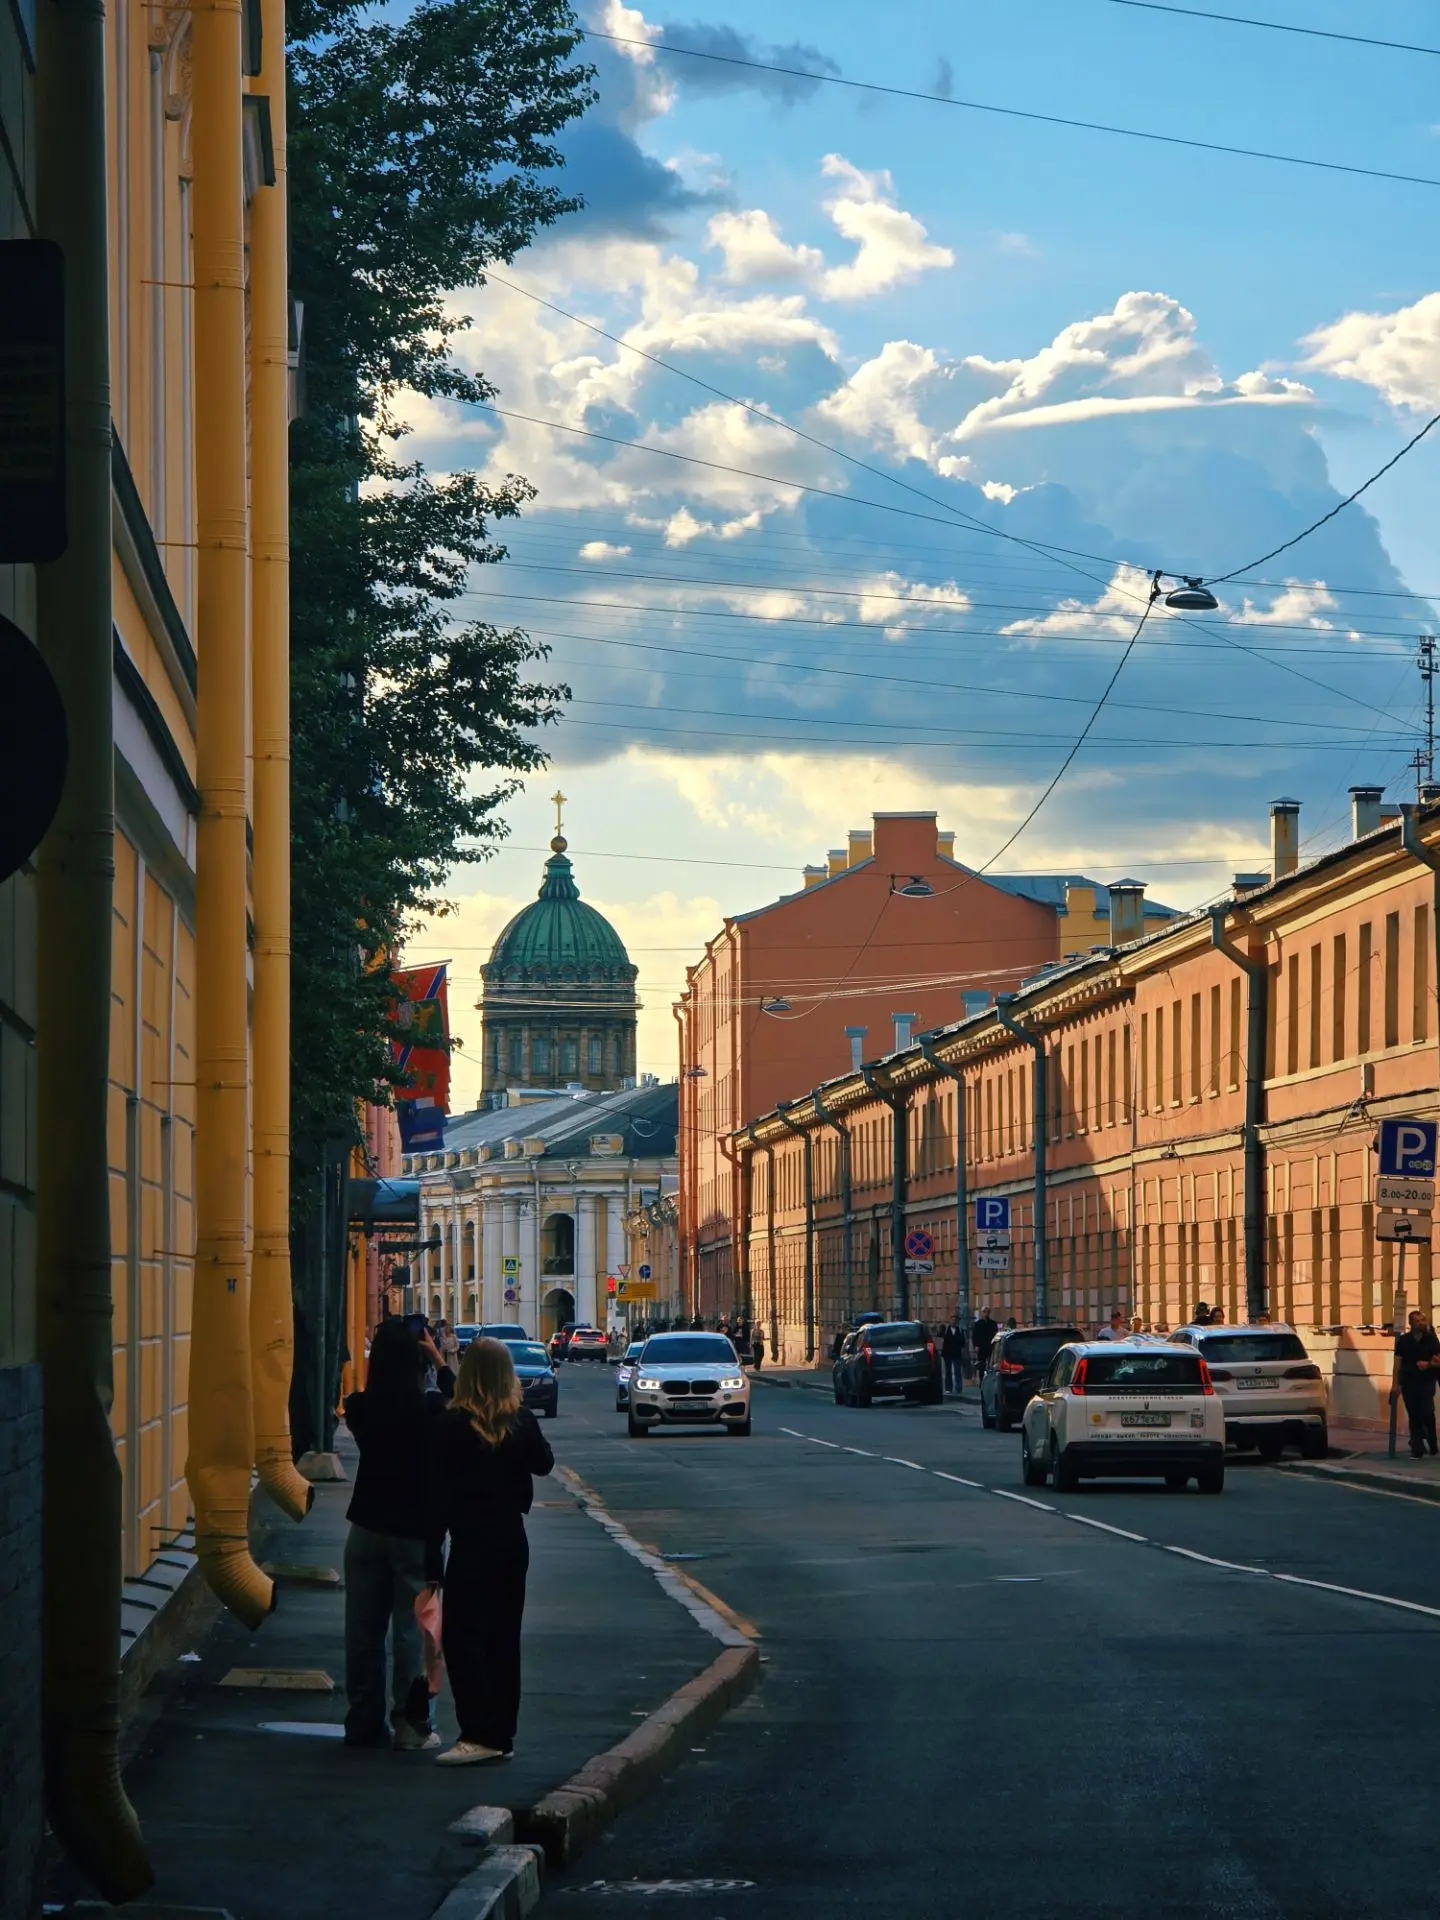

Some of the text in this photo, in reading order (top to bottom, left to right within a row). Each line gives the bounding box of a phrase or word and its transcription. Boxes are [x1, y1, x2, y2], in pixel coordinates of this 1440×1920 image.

[1395, 1127, 1427, 1170] P
[1381, 1188, 1432, 1200] 8.00-20.00
[985, 1201, 1003, 1226] P
